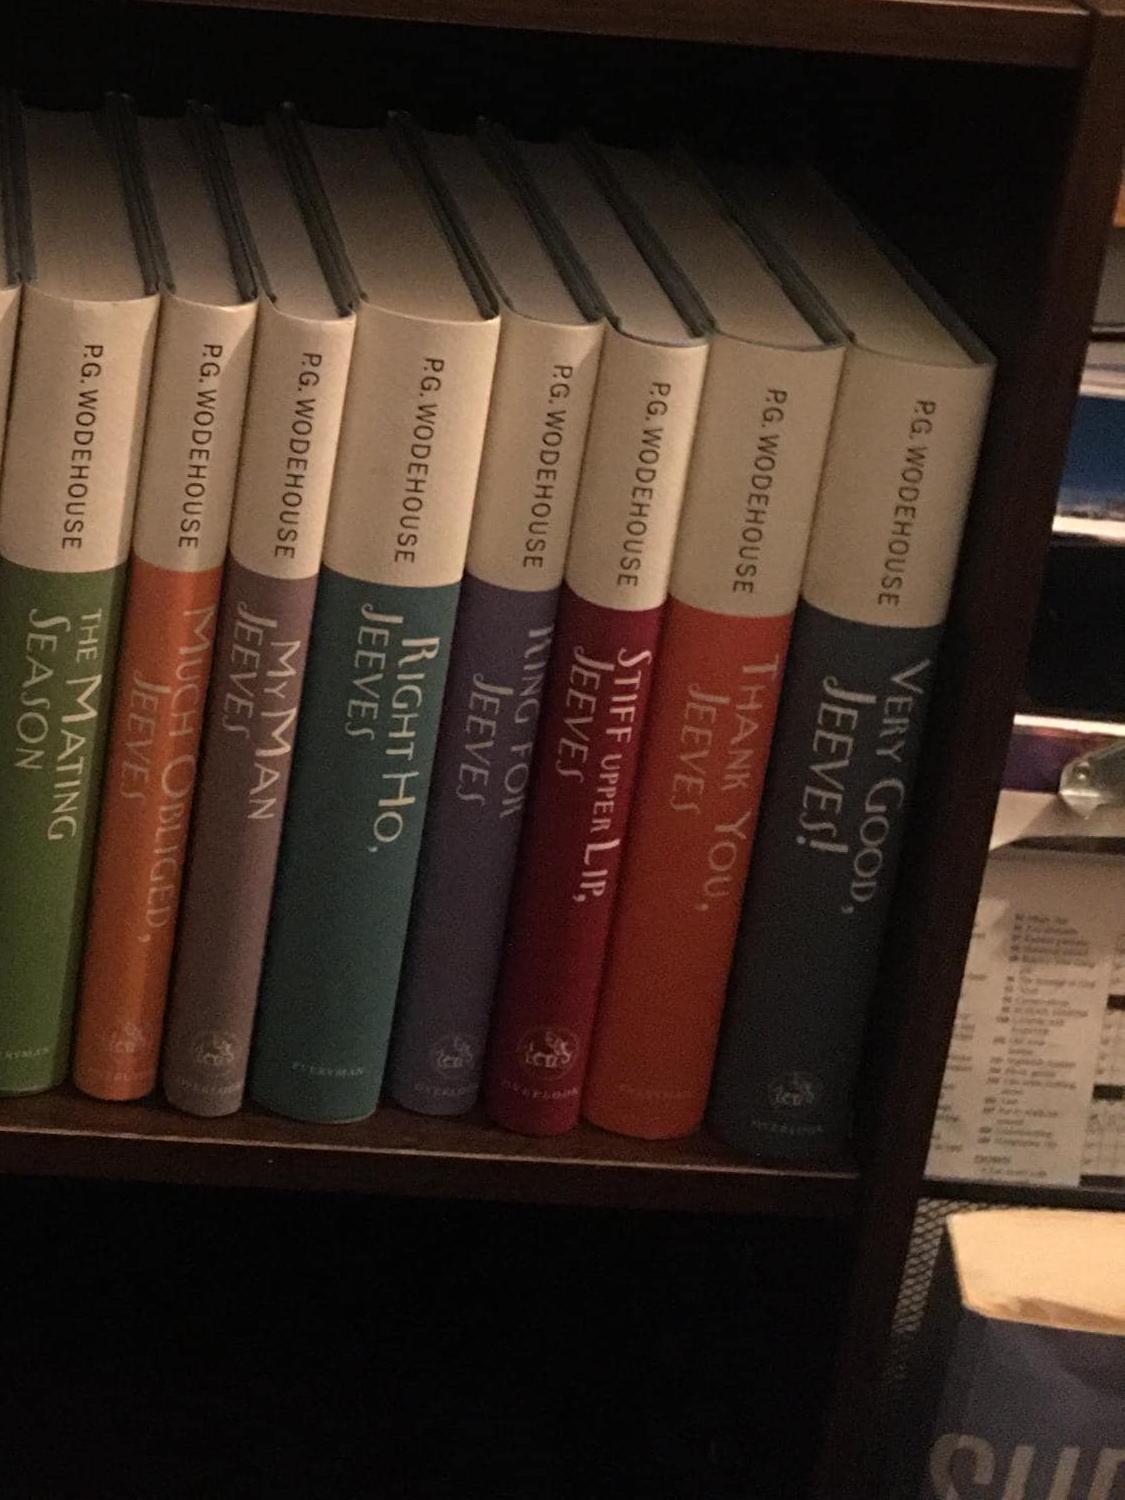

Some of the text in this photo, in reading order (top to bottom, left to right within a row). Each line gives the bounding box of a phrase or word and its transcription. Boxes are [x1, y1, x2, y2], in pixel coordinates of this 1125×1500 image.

[62, 345, 103, 548] P.G. WODEHOUSE
[178, 344, 223, 548] P.G. WODEHOUSE
[275, 353, 322, 558] P.G. WODEHOUSE
[394, 358, 445, 563] P.G. WODEHOUSE
[523, 365, 573, 573] P.G. WODEHOUSE
[617, 382, 671, 586] P.G. WODEHOUSE
[733, 389, 787, 593] P.G. WODEHOUSE
[878, 400, 936, 606] P.G. WODEHOUSE
[14, 609, 71, 770] SEASON
[47, 608, 103, 841] THE MATING
[120, 670, 172, 801] JEEVES
[169, 604, 216, 737] MUCH
[222, 601, 277, 739] JEEVES
[245, 637, 301, 822] MY MAN
[344, 602, 404, 741] JEEVES
[365, 636, 441, 853] RIGHT HO,
[455, 673, 514, 807] JEEVES
[554, 643, 615, 784] JEEVES
[669, 682, 731, 815] JEEVES
[795, 676, 876, 855] JEEVES!
[571, 648, 652, 902] STIFF UPPER LIP,
[695, 654, 781, 913] THANK YOU,
[840, 658, 932, 916] VERY GOOD,
